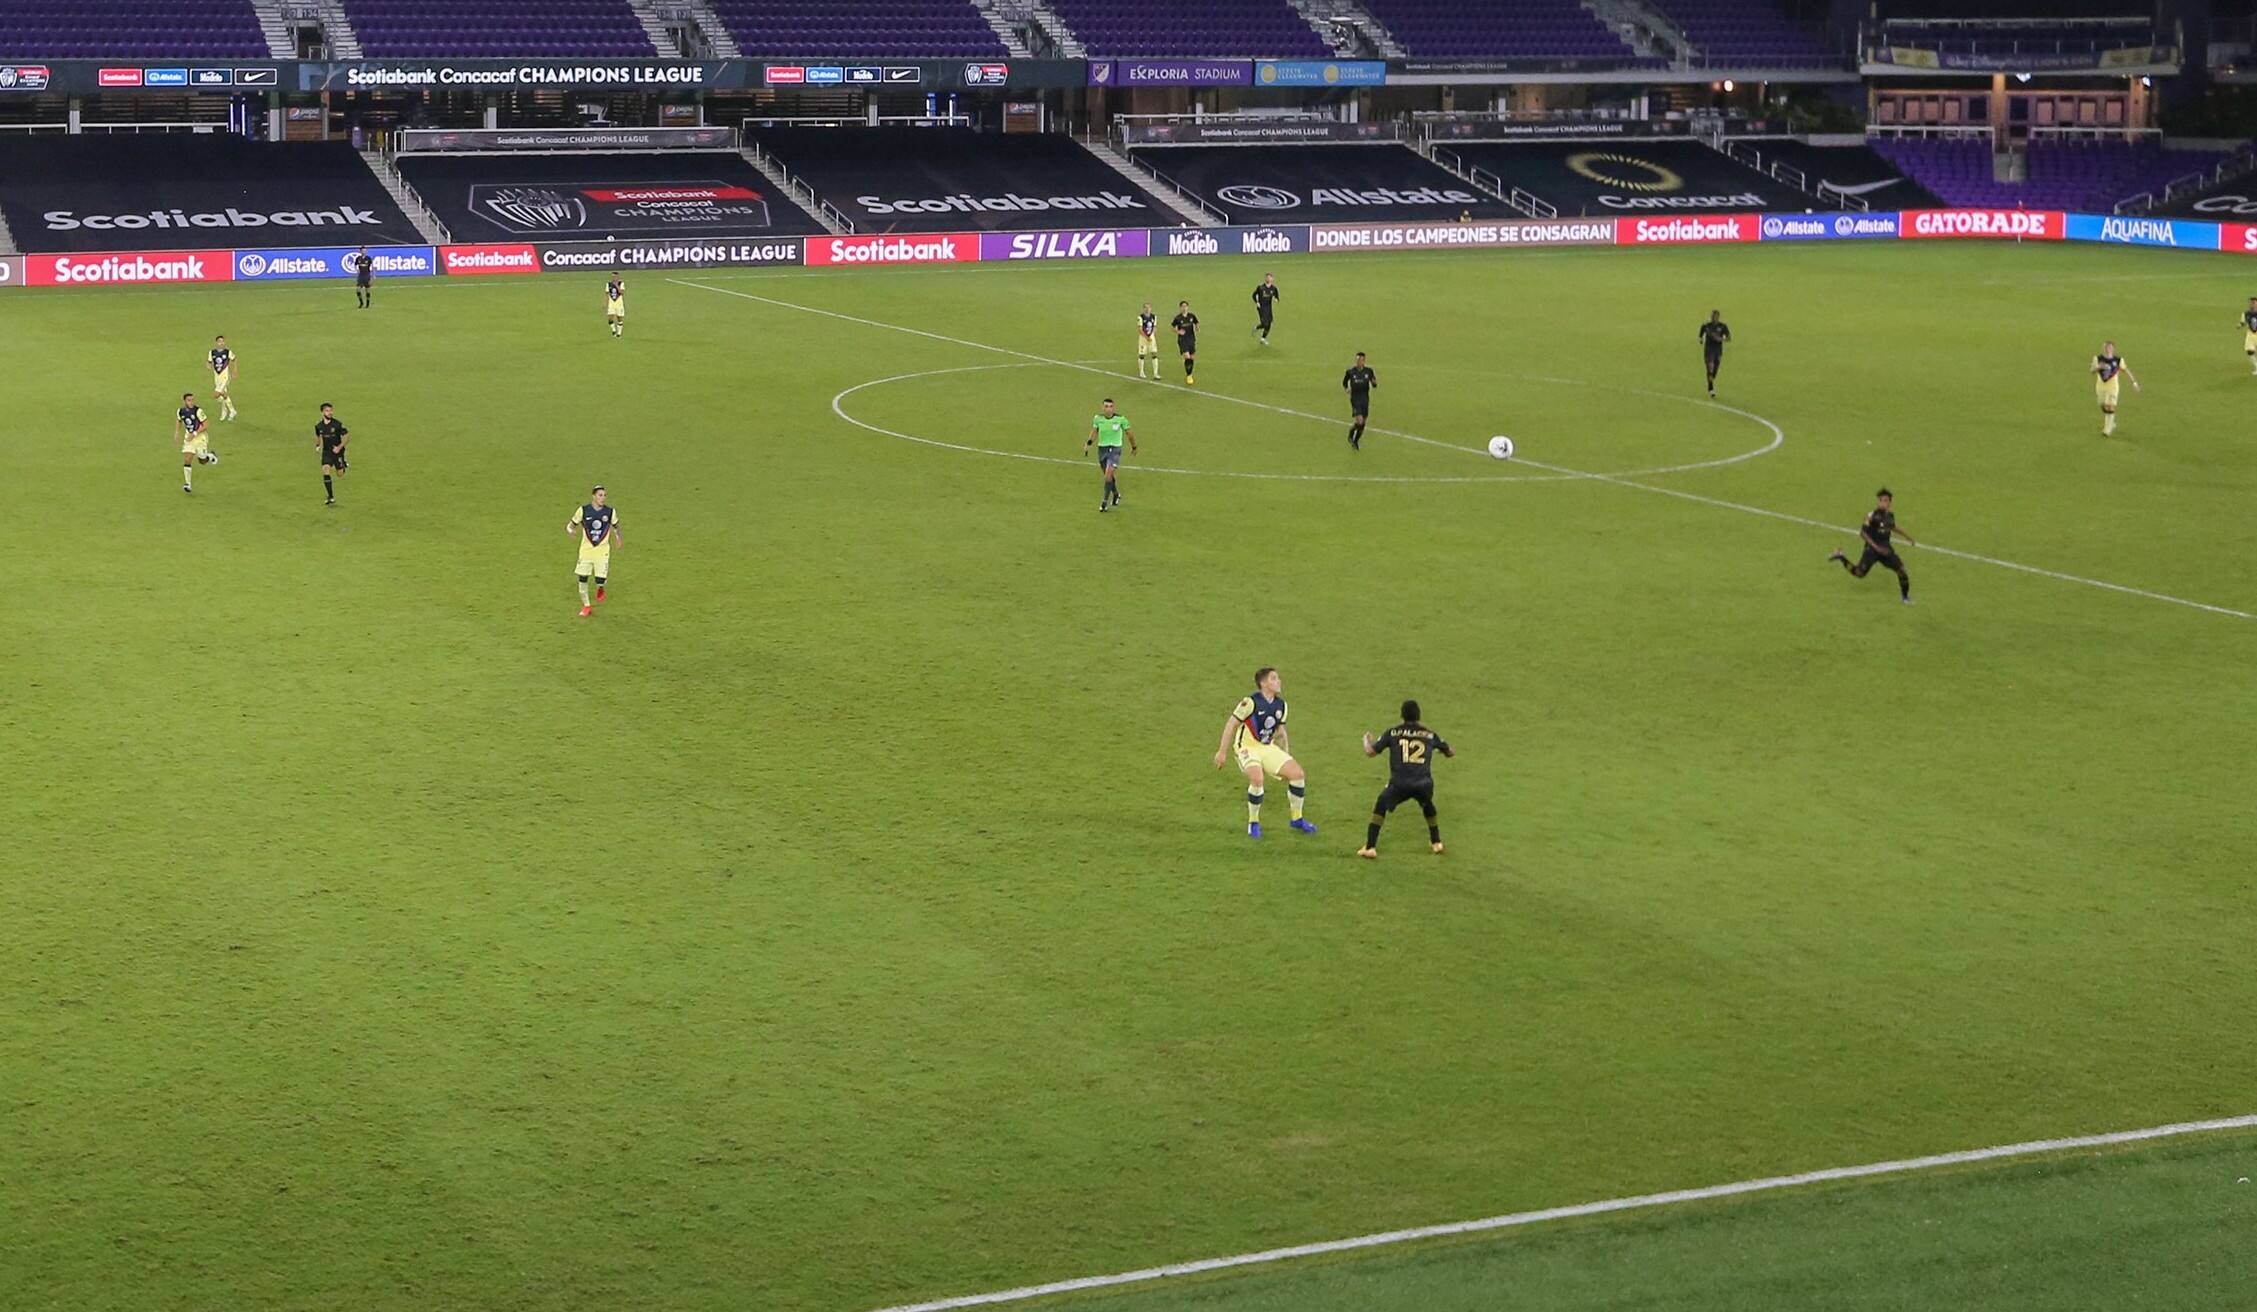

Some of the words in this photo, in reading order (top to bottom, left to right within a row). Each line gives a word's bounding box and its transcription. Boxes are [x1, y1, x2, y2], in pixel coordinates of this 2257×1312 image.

[347, 69, 437, 85] Scotiabank
[440, 68, 516, 84] Concacaf
[519, 67, 630, 83] CHAMPIONS
[634, 67, 703, 83] LEAGUE
[1130, 65, 1189, 80] EXPLORIA
[1194, 68, 1241, 80] STADIUM
[497, 136, 535, 145] Scotiabank
[569, 135, 618, 144] CHAMPIONS
[619, 135, 649, 143] LEAGUE
[1303, 127, 1329, 136] LEAGUE
[614, 190, 718, 200] Scotiabank
[637, 200, 714, 208] Concacaf
[857, 191, 1147, 214] Scotiabank
[1312, 186, 1478, 206] Allstate
[43, 206, 383, 231] Scotiabank
[614, 205, 753, 217] CHAMPIONS
[661, 214, 722, 222] LEAGUE
[1636, 218, 1740, 242] Scotiabank
[1783, 221, 1825, 235] Allstate
[1915, 212, 2046, 235] GATORADE
[2101, 217, 2177, 246] AQUAFINA
[1009, 232, 1118, 259] SILKA
[1169, 233, 1219, 255] Modelo
[1242, 232, 1292, 253] Modelo
[1316, 230, 1371, 247] DONDE
[1373, 229, 1403, 245] LOS
[1405, 227, 1498, 245] CAMPEONES
[1500, 227, 1519, 242] SE
[1521, 224, 1611, 241] CONSAGRAN
[448, 250, 533, 268] Scotiabank
[543, 249, 617, 266] Concacaf
[620, 246, 726, 264] CHAMPIONS
[730, 244, 797, 262] LEAGUE
[831, 237, 956, 263] Scotiabank
[55, 255, 205, 283] Scotiabank
[1399, 739, 1425, 764] 12
